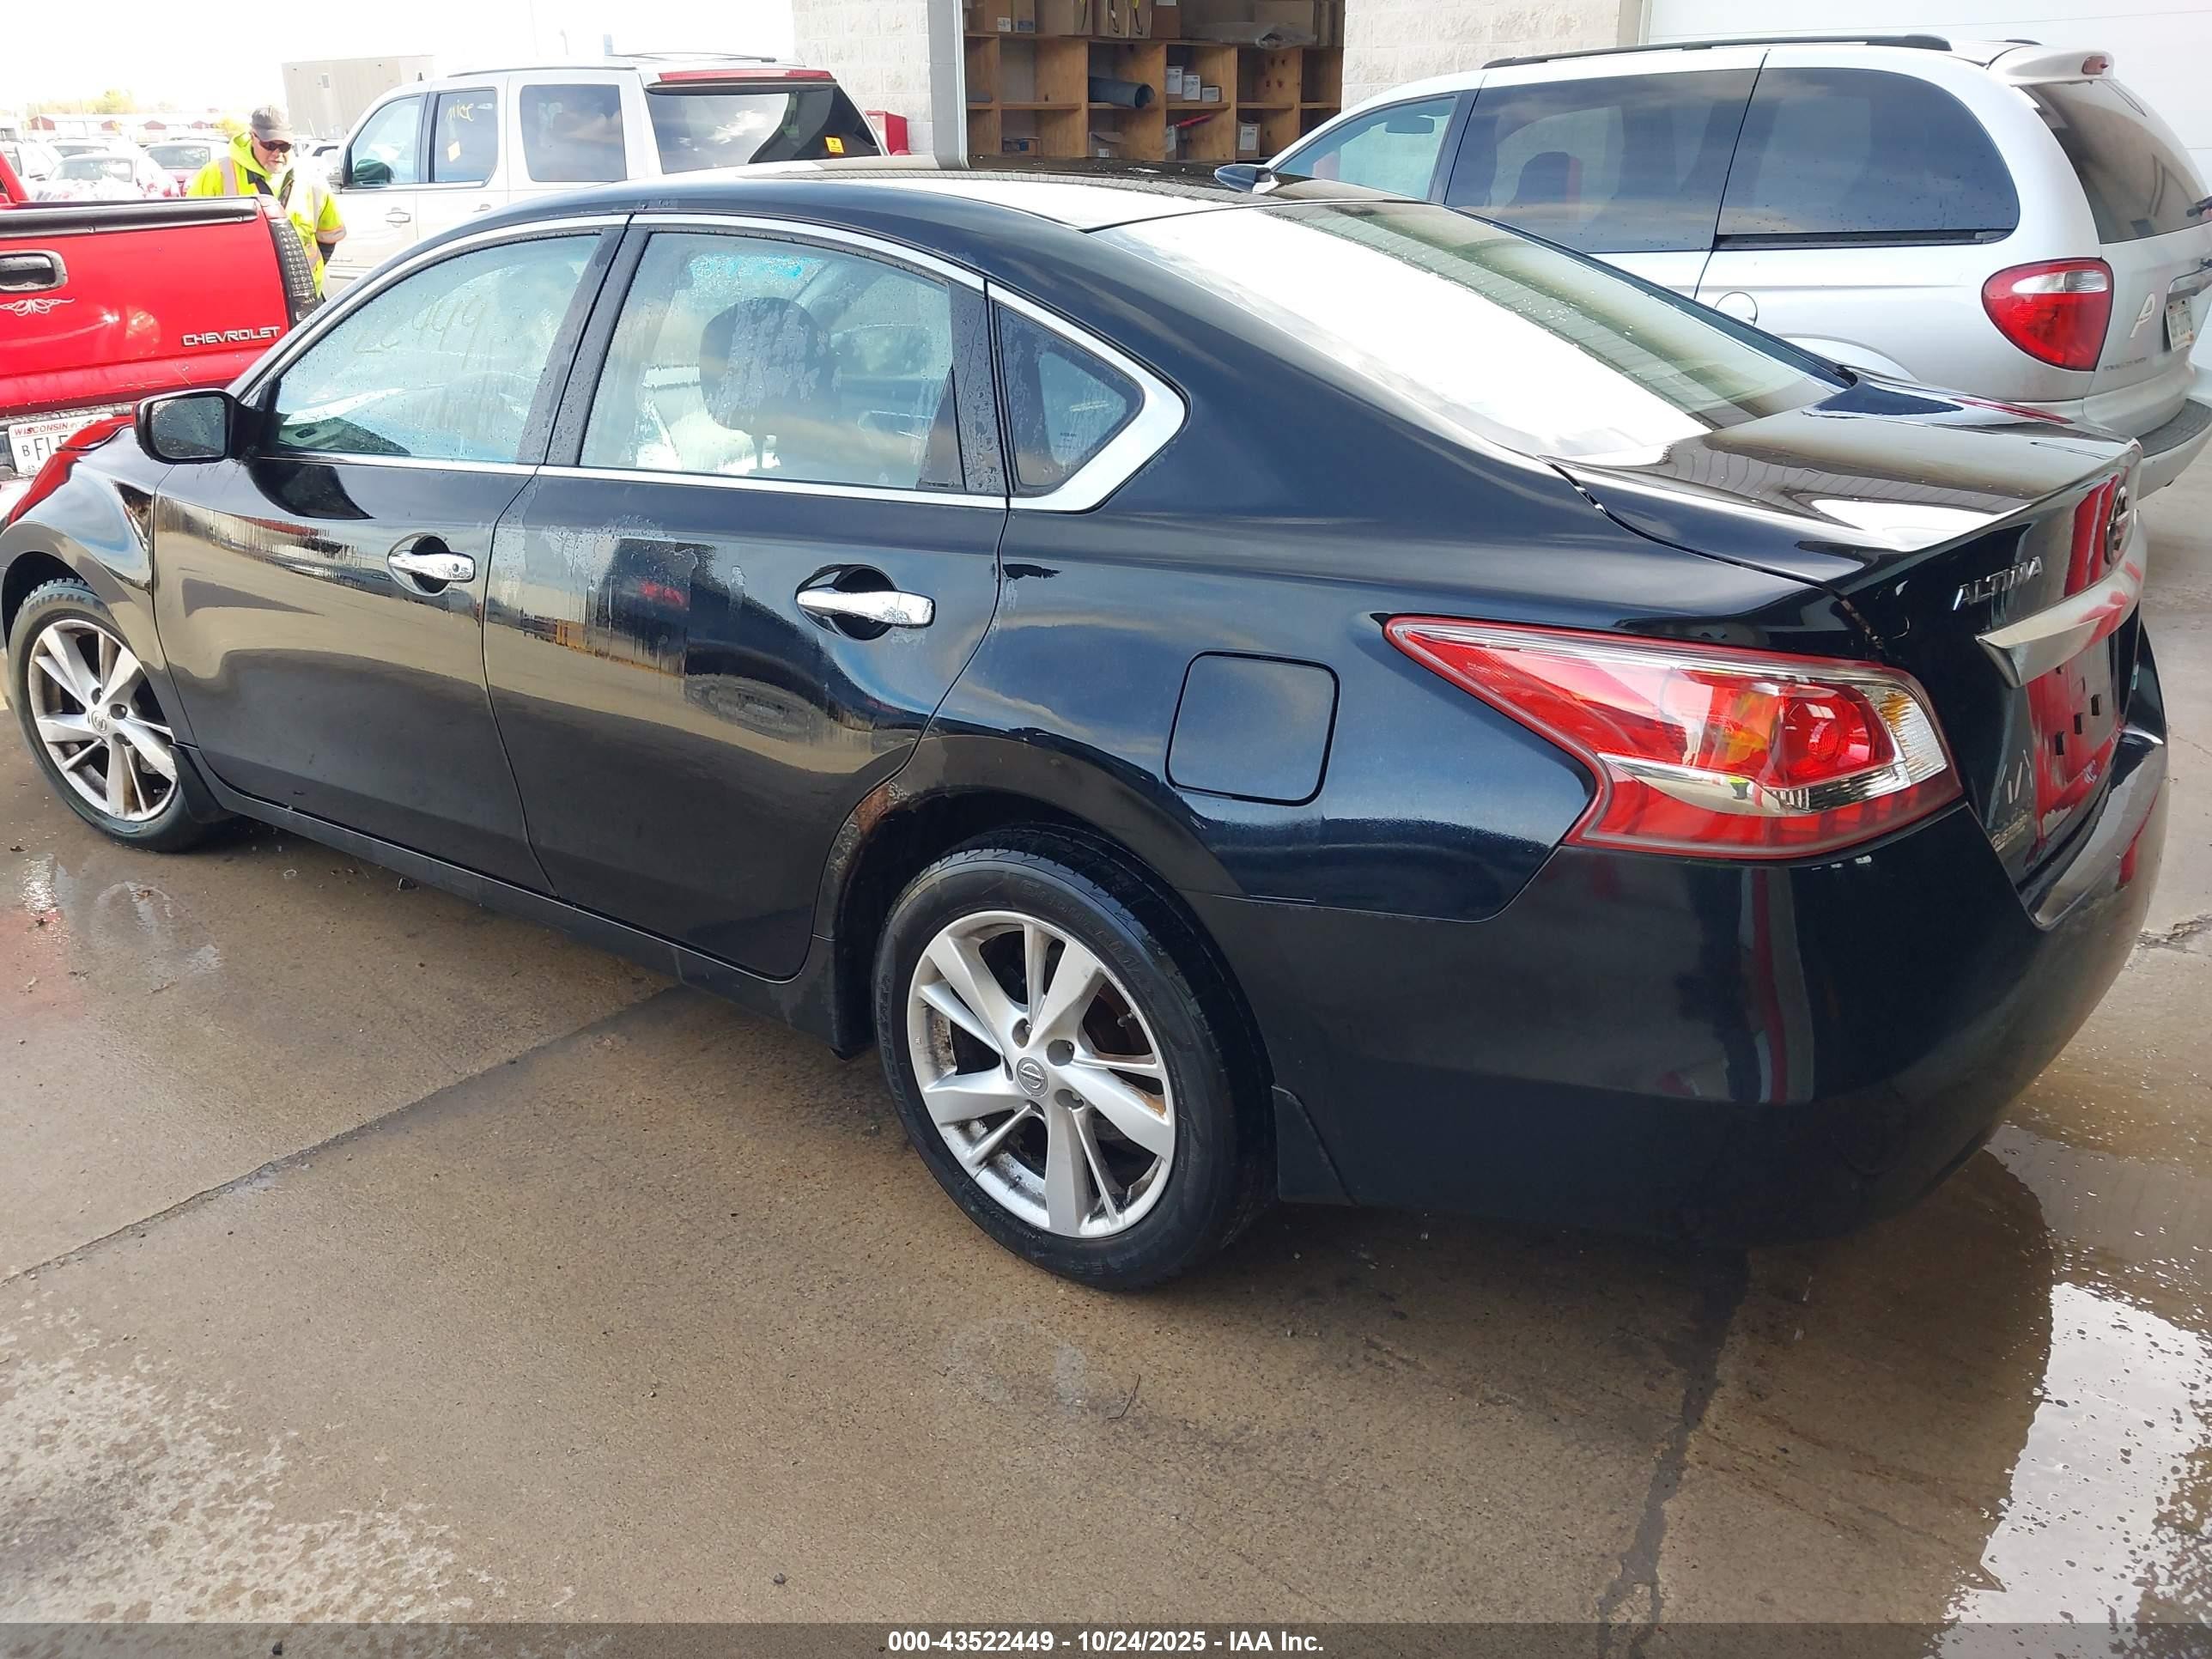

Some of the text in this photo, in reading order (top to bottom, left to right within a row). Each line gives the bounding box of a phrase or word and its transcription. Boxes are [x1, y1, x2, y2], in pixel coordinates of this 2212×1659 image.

[181, 325, 281, 347] CHEVROLET
[14, 422, 69, 436] WISCONSIN
[1952, 556, 2044, 611] ALTIMA
